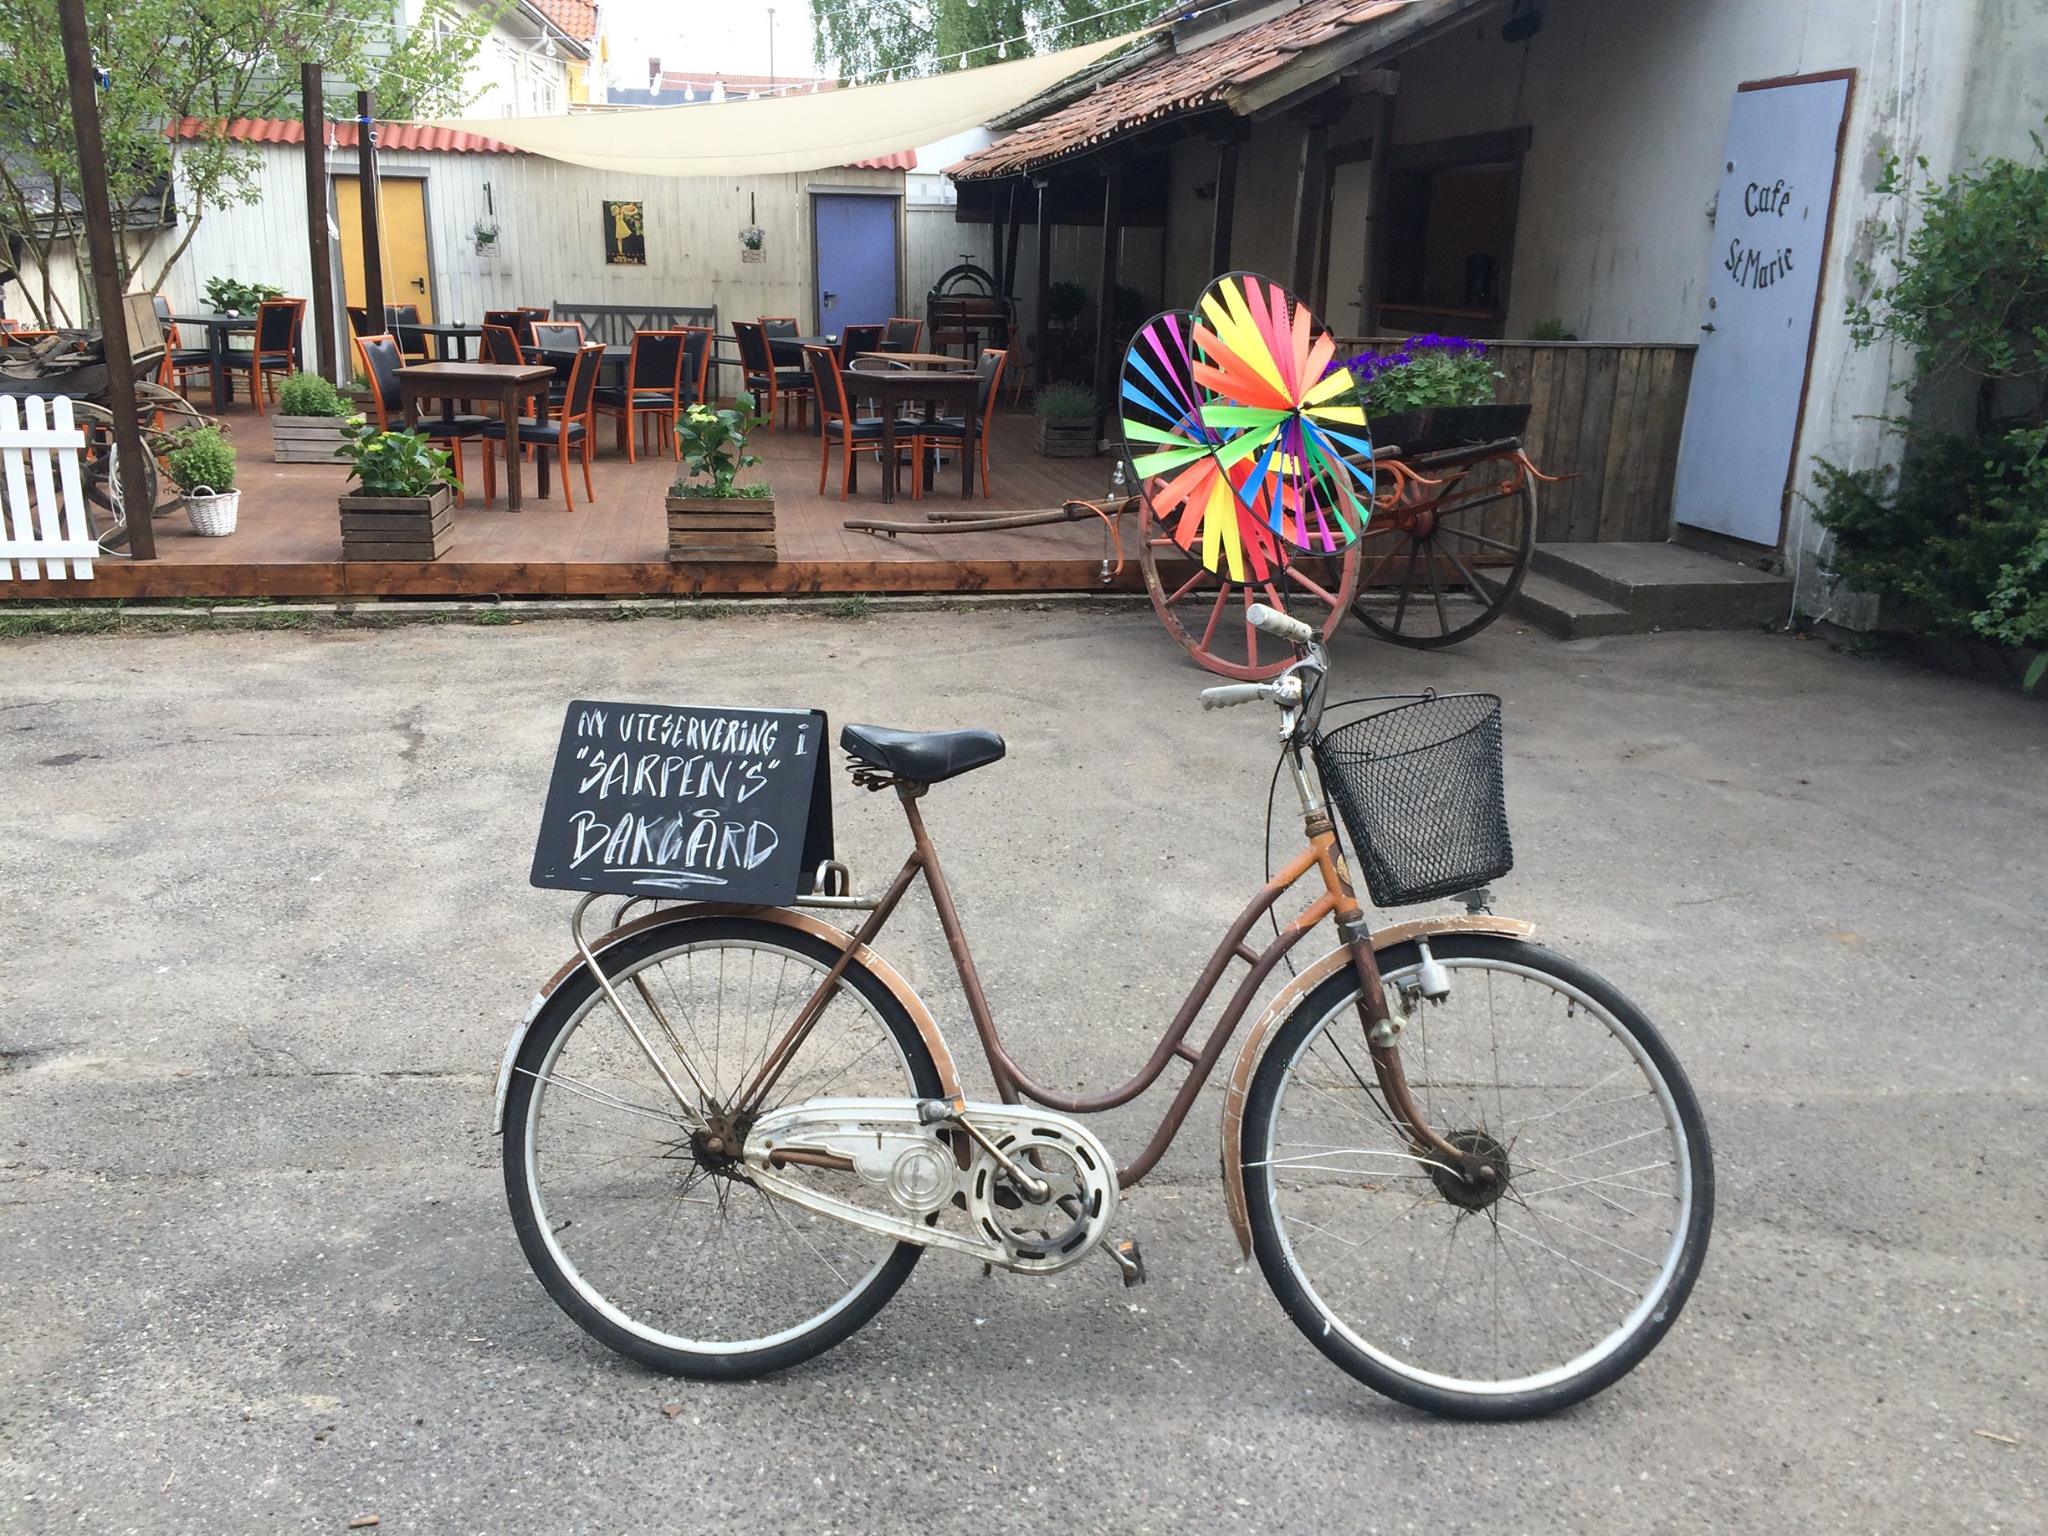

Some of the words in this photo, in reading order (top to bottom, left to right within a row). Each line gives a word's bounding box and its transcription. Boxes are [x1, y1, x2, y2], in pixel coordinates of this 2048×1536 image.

[1744, 178, 1794, 218] Café
[577, 707, 609, 739] NY
[568, 808, 780, 871] BAKGÅRD
